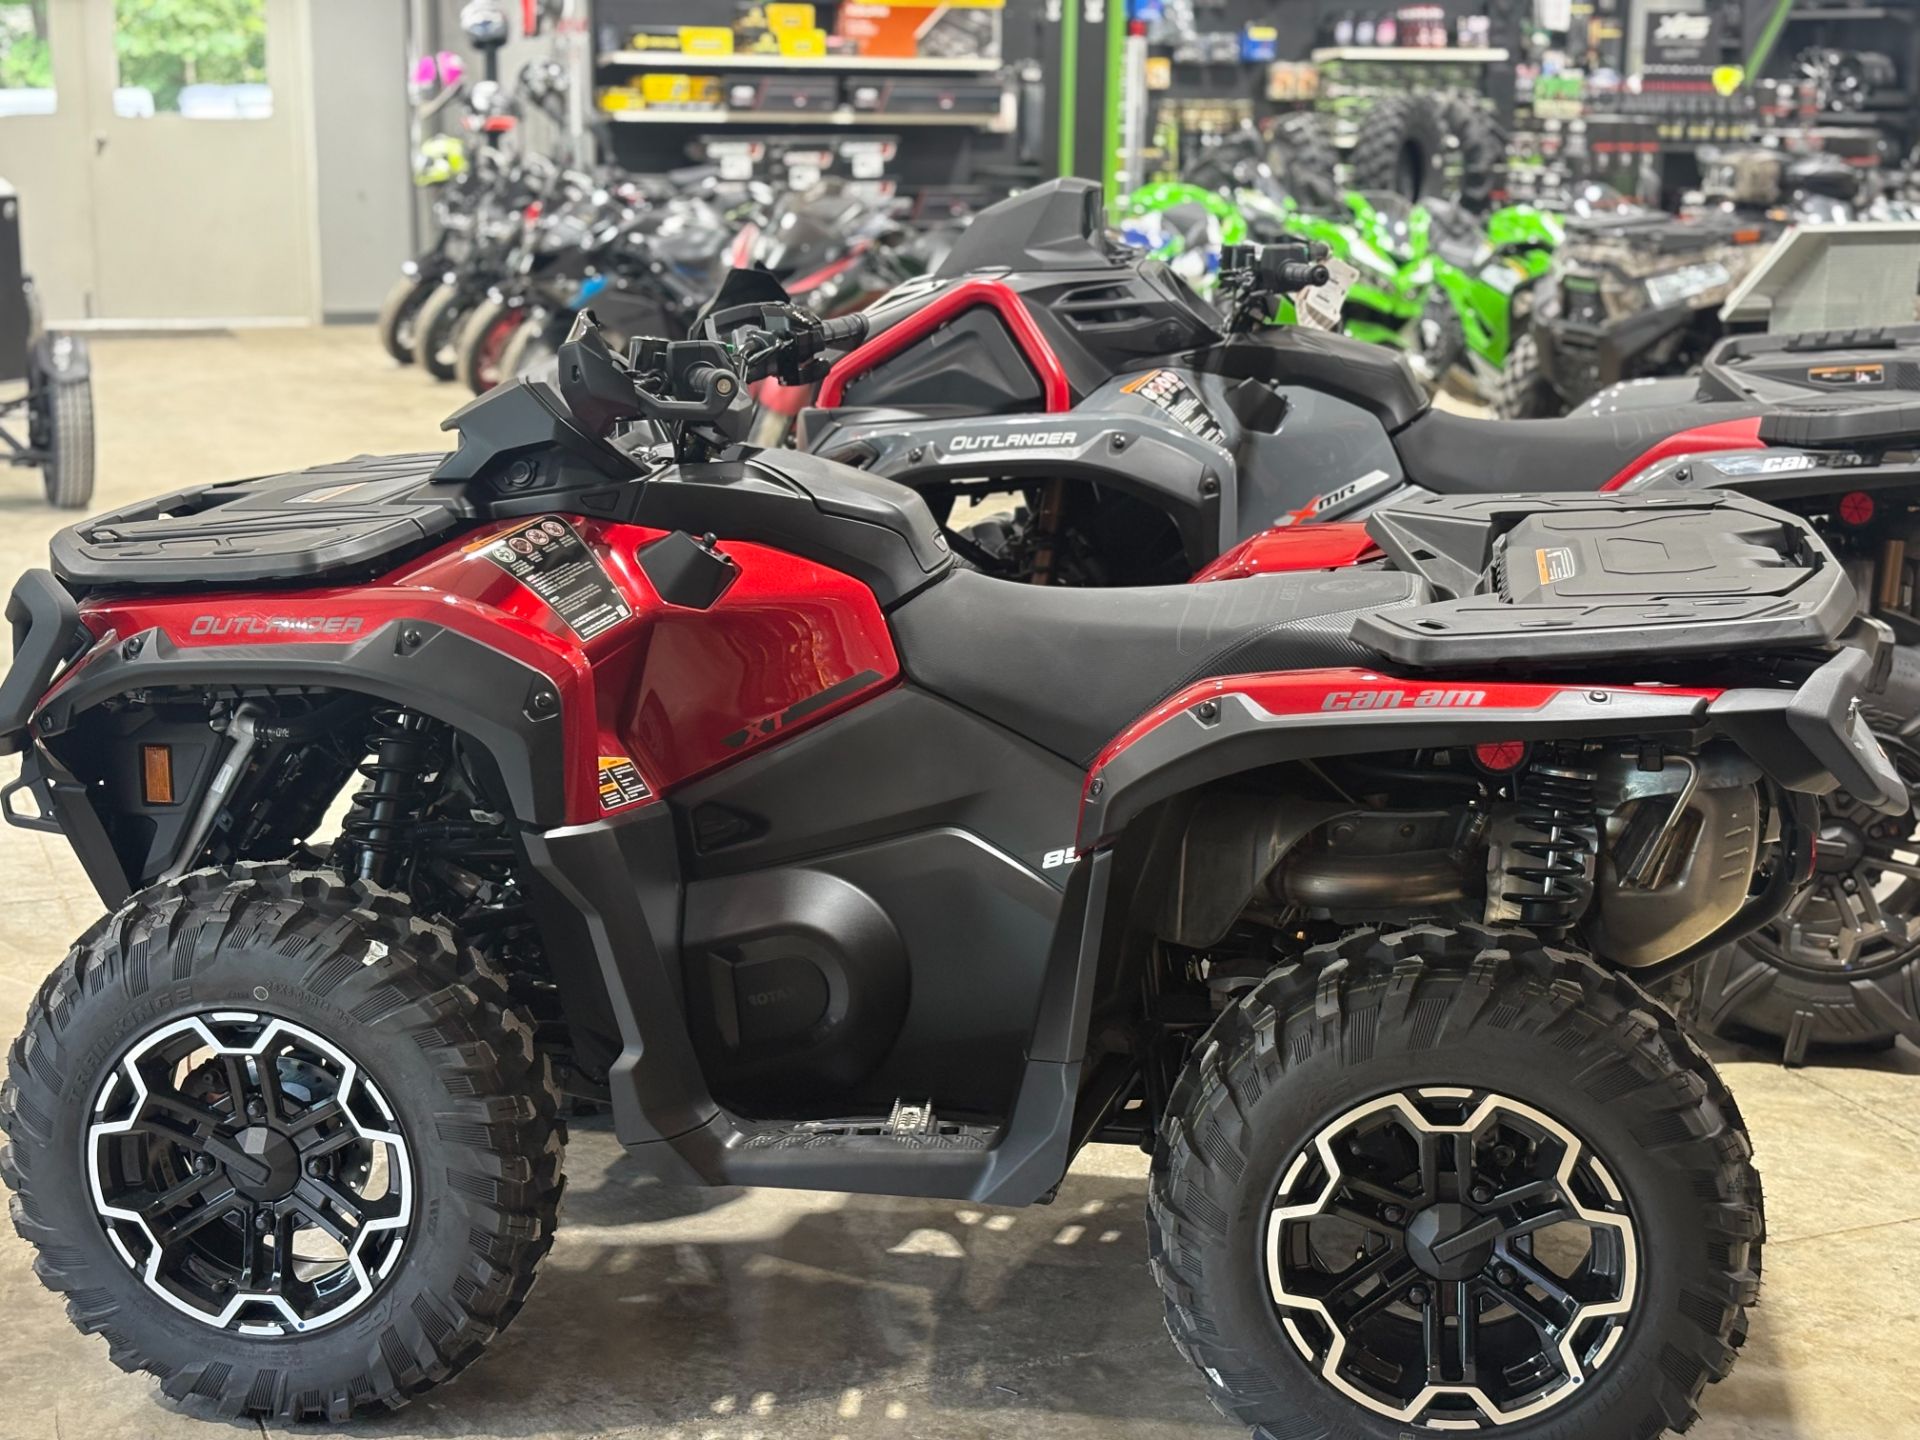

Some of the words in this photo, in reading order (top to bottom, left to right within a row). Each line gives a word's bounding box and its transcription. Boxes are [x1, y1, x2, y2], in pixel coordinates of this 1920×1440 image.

[949, 432, 1077, 450] OUTLANDER
[190, 615, 363, 635] OUTLANDER
[1321, 689, 1486, 711] can-am
[745, 709, 783, 744] XT
